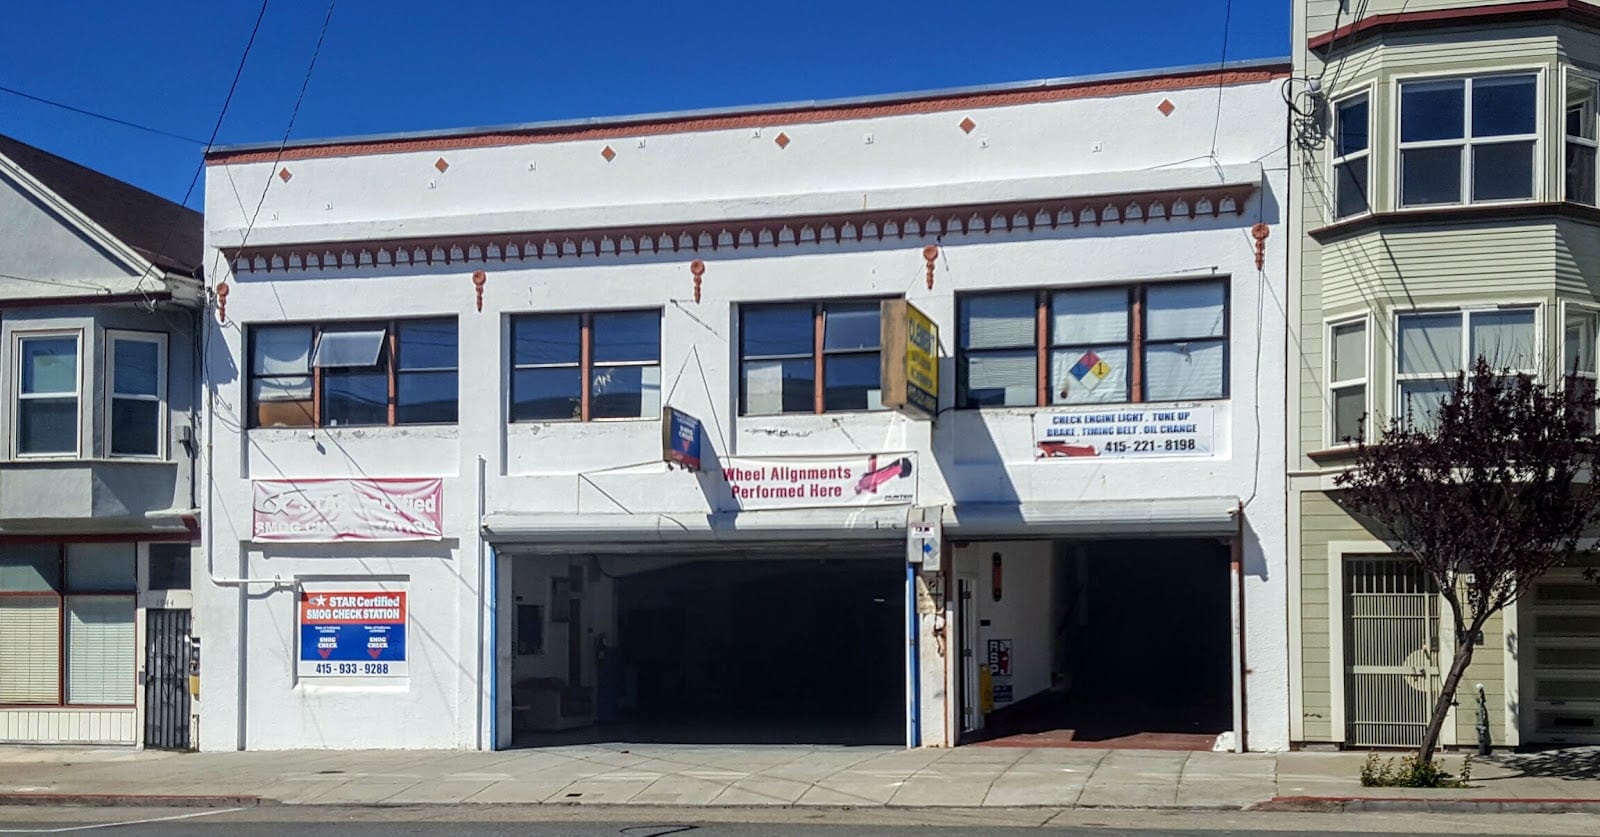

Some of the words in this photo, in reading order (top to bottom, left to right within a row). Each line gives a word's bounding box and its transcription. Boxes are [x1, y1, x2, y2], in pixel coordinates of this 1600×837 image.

[1053, 415, 1082, 424] CHECK
[1084, 414, 1115, 424] ENGINE
[1153, 412, 1176, 421] TUNE
[1178, 411, 1191, 420] UP
[1082, 426, 1114, 436] TIMING
[1144, 425, 1158, 434] OIL
[1160, 423, 1198, 433] CHANGE
[722, 467, 765, 482] Wheel
[771, 466, 852, 483] Alignments
[731, 484, 805, 499] Performed
[810, 484, 842, 498] Here
[329, 596, 356, 607] STAR
[357, 596, 400, 607] Certified
[306, 608, 331, 619] SMOG
[333, 608, 362, 619] CHECK
[362, 608, 400, 619] STATION
